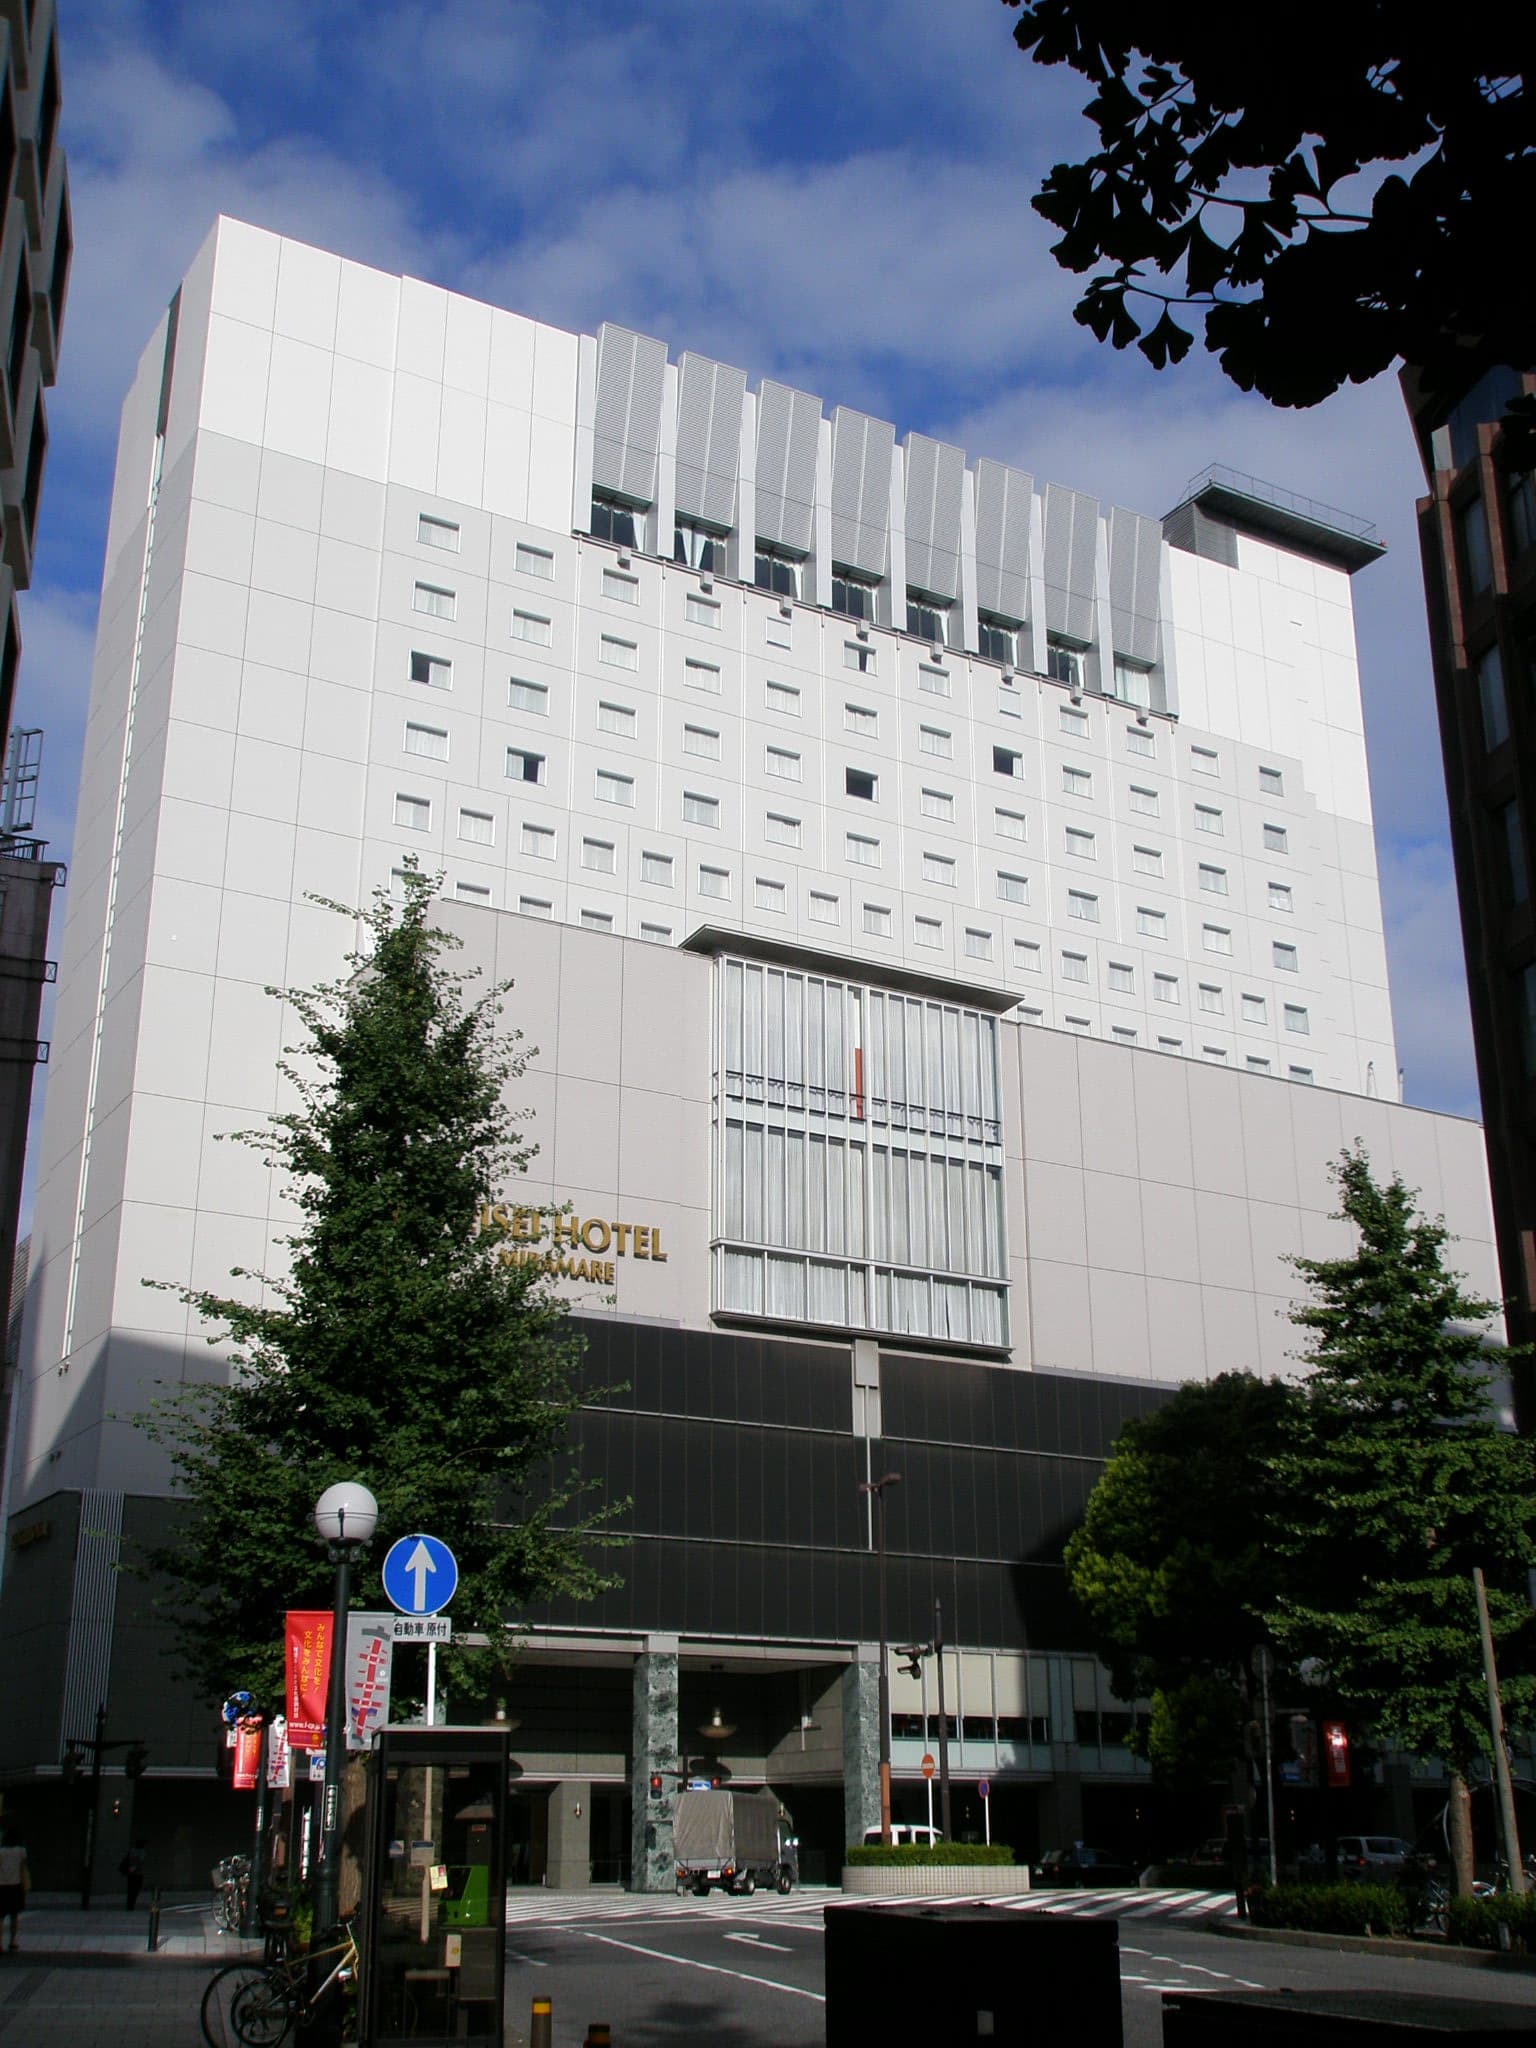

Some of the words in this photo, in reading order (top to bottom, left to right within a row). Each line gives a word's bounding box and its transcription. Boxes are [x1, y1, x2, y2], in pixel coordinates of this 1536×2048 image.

[553, 1213, 668, 1260] HOTEL
[394, 1622, 424, 1636] 自動車
[427, 1623, 447, 1637] 原付
